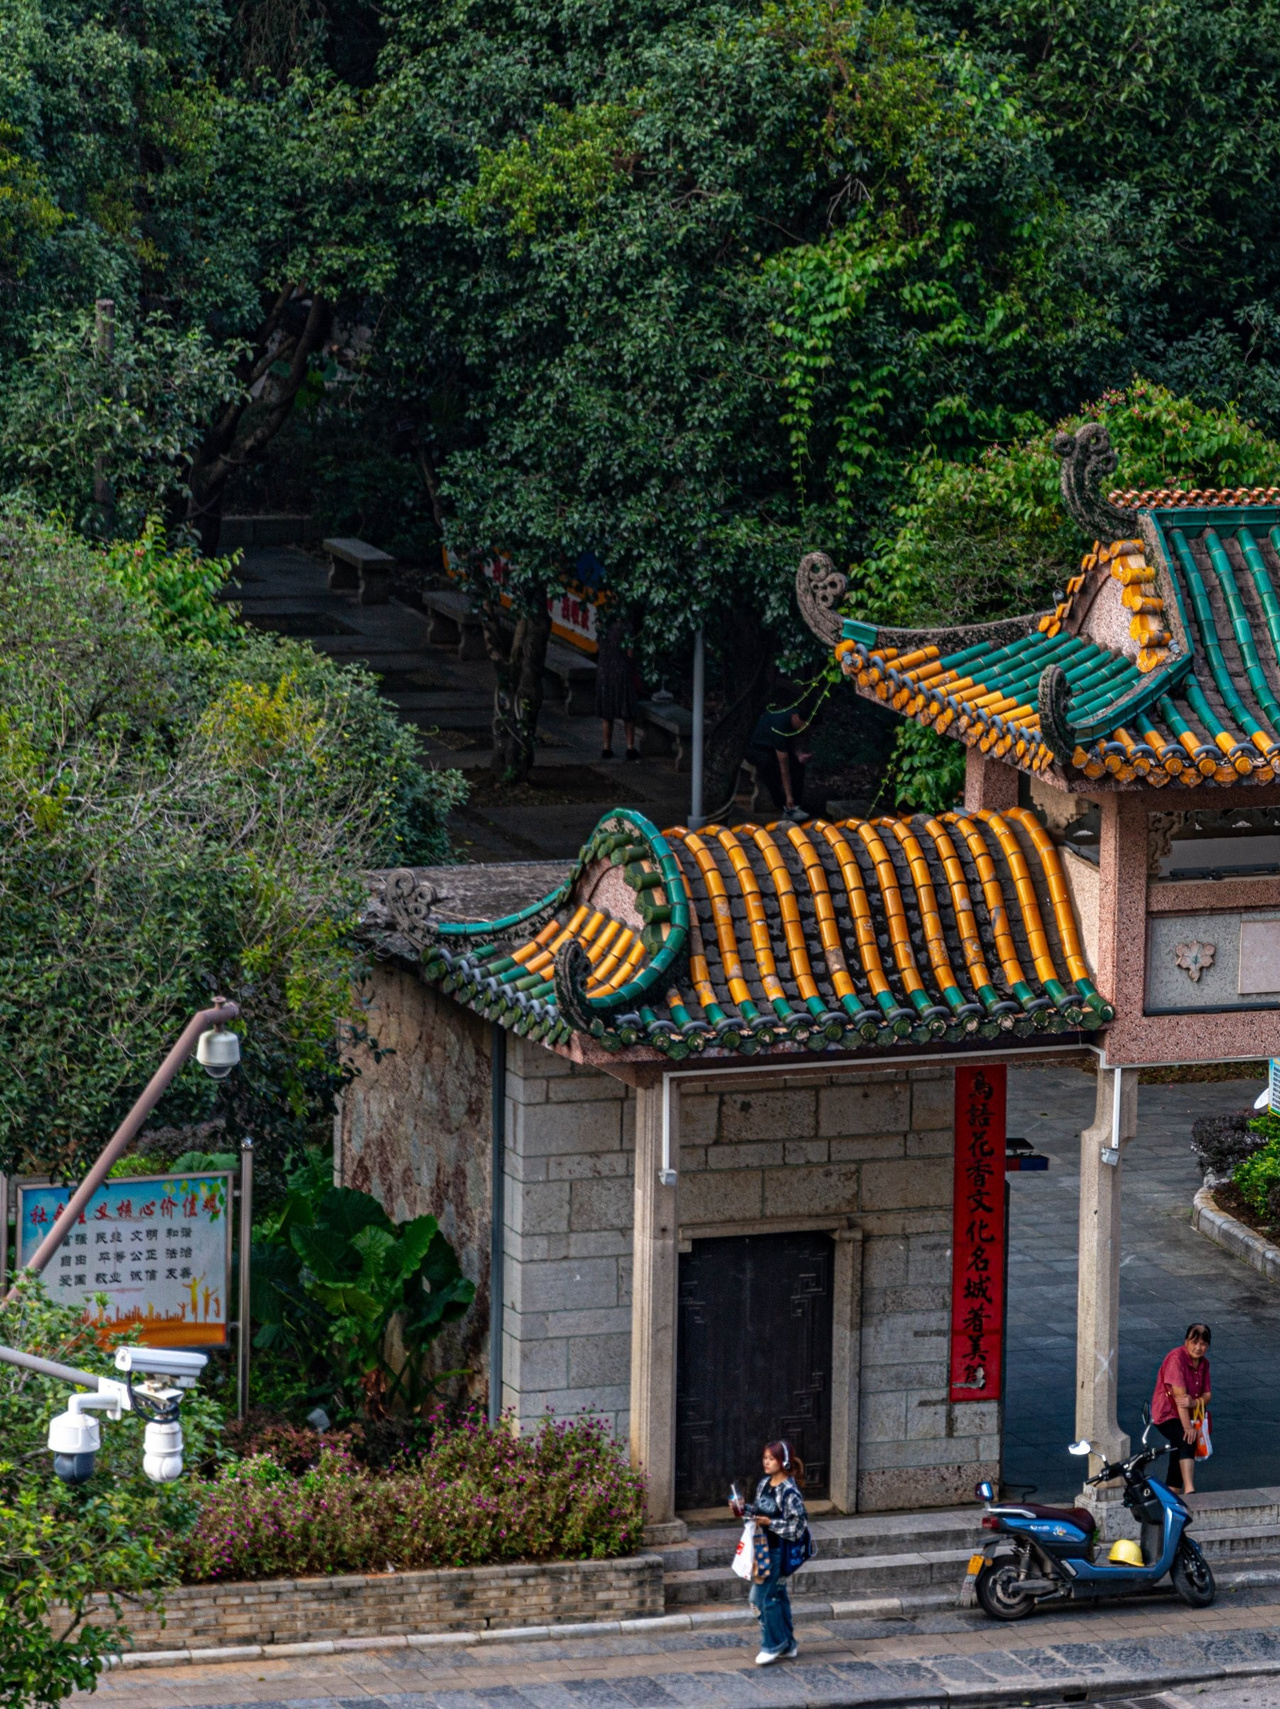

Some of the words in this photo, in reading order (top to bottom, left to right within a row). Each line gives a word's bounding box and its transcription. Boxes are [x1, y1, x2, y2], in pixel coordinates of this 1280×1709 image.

[130, 1230, 158, 1241] 文明
[165, 1227, 192, 1240] 和谐
[61, 1255, 87, 1267] 自由
[130, 1249, 158, 1262] 公正
[165, 1246, 192, 1260] 法治
